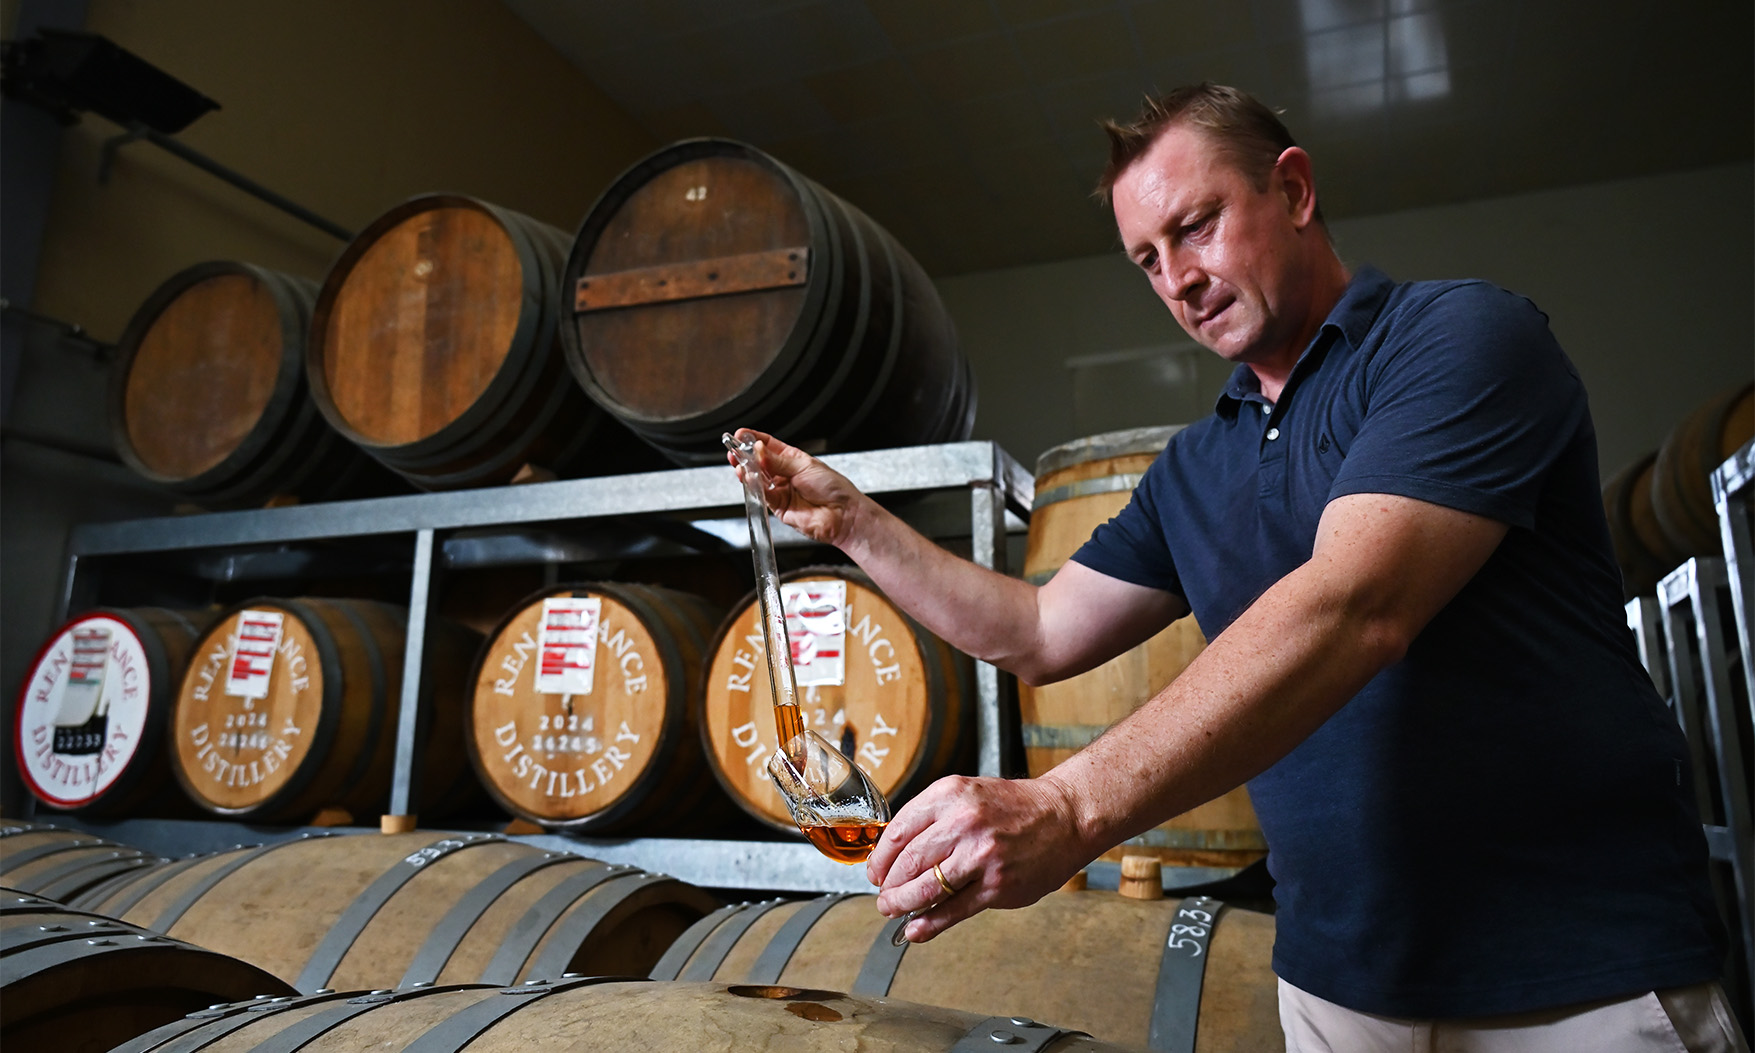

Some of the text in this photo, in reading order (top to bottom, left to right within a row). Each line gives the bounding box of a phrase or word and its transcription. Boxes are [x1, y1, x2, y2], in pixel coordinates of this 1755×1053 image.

[494, 619, 648, 697] RENANCE
[32, 722, 128, 786] DISTILLERY
[190, 716, 301, 788] DISTILLERY
[539, 714, 594, 732] 2024
[494, 721, 641, 798] DISTILLERY
